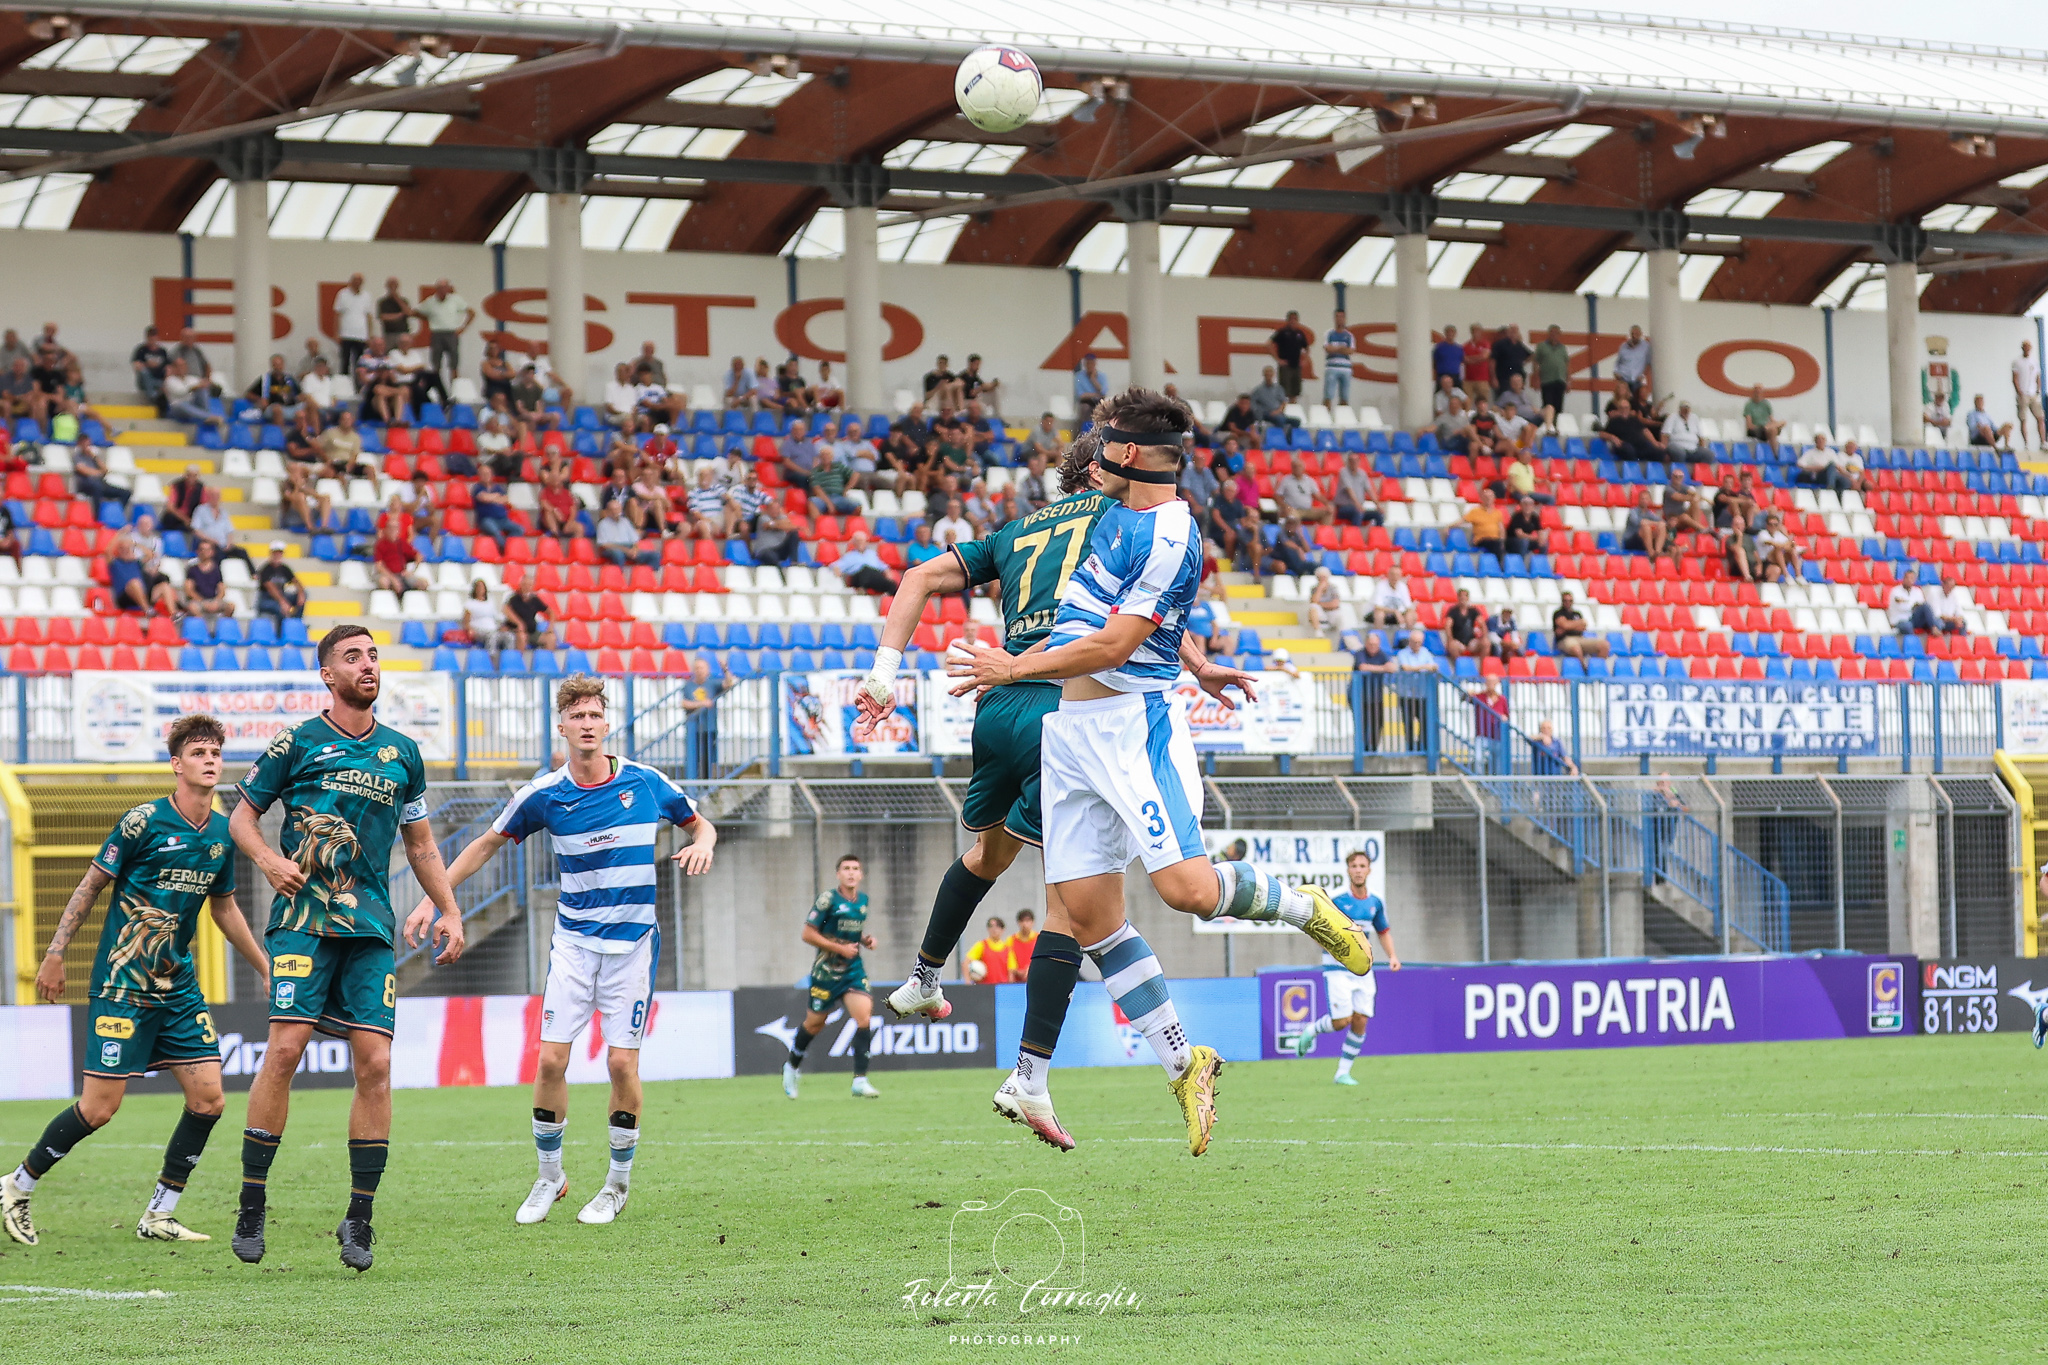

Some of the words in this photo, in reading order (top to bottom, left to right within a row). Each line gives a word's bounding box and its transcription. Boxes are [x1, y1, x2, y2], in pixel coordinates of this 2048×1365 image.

[1039, 310, 1822, 399] ARSZO
[1013, 514, 1094, 614] 77
[179, 692, 212, 712] UN
[219, 692, 277, 713] SOLO
[1608, 683, 1668, 701] PRO
[1682, 684, 1789, 703] PATRIA
[1803, 685, 1875, 703] CLUB
[1625, 704, 1862, 730] MARNATE
[1610, 730, 1677, 748] SEZ.
[321, 780, 395, 807] SIDERURGICA
[322, 769, 398, 796] FERALPI
[1141, 800, 1166, 837] 3
[590, 833, 613, 844] HUPAC
[382, 973, 396, 1009] 8
[631, 999, 644, 1029] 6
[1464, 980, 1562, 1040] PRO
[1570, 975, 1736, 1036] PATRIA
[1924, 996, 1998, 1034] 81:53
